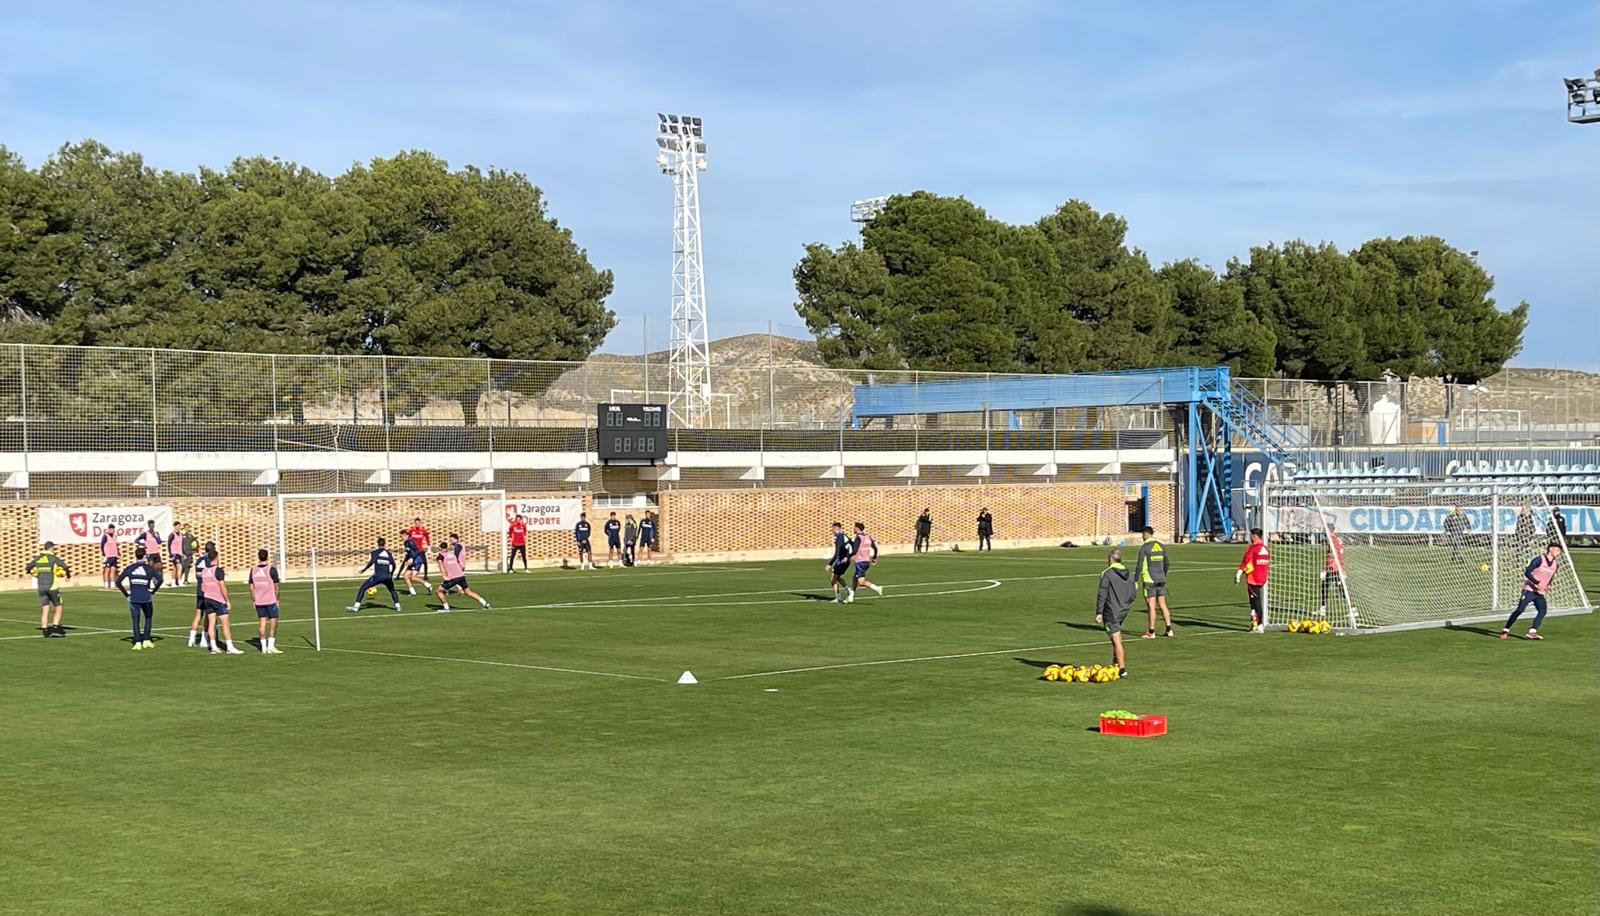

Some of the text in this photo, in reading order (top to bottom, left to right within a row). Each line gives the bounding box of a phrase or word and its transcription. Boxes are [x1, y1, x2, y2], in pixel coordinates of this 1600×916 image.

[521, 503, 561, 515] Zaragoza
[92, 512, 145, 526] Zaragoza
[1350, 508, 1453, 531] CIUDAD
[93, 525, 144, 538] DEORTE
